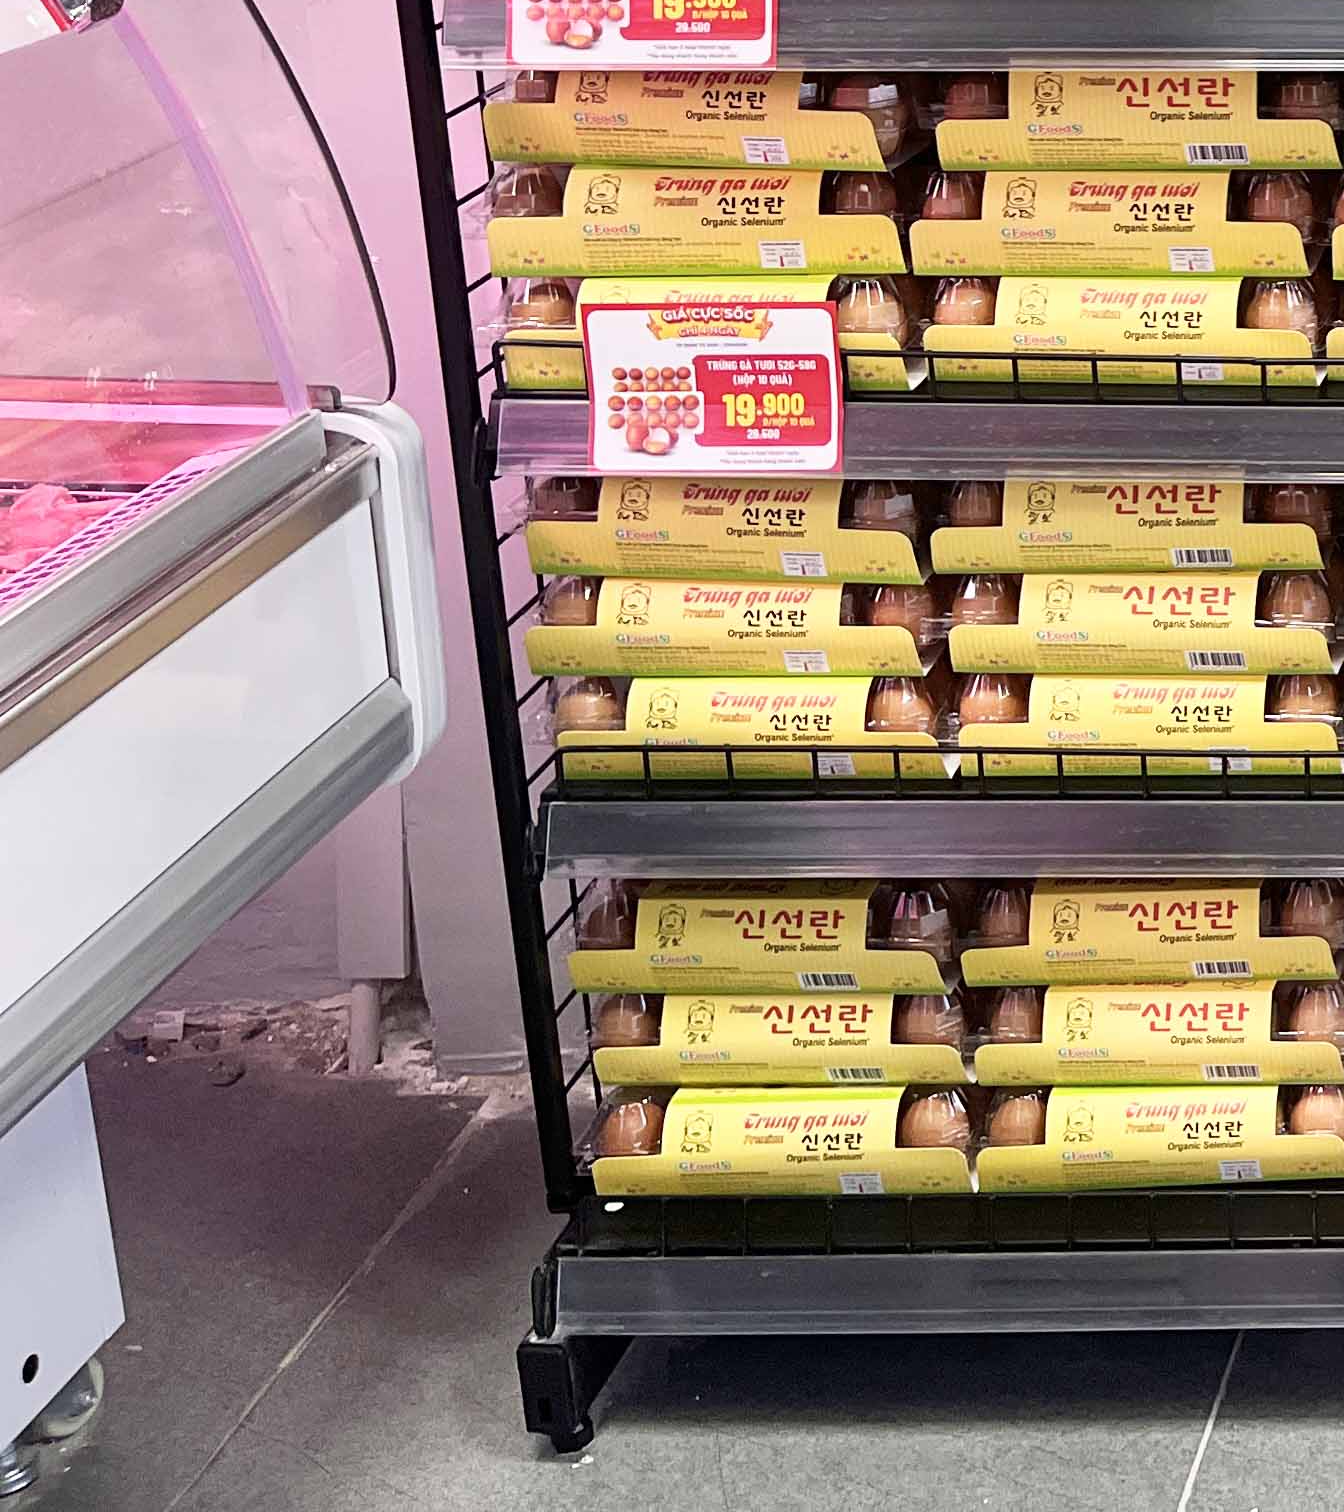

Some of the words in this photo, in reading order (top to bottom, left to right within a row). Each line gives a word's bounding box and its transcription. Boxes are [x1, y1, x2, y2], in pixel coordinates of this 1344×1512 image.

[1116, 76, 1236, 109] 신선란
[722, 393, 805, 427] 19.900
[733, 908, 847, 941] 신선란
